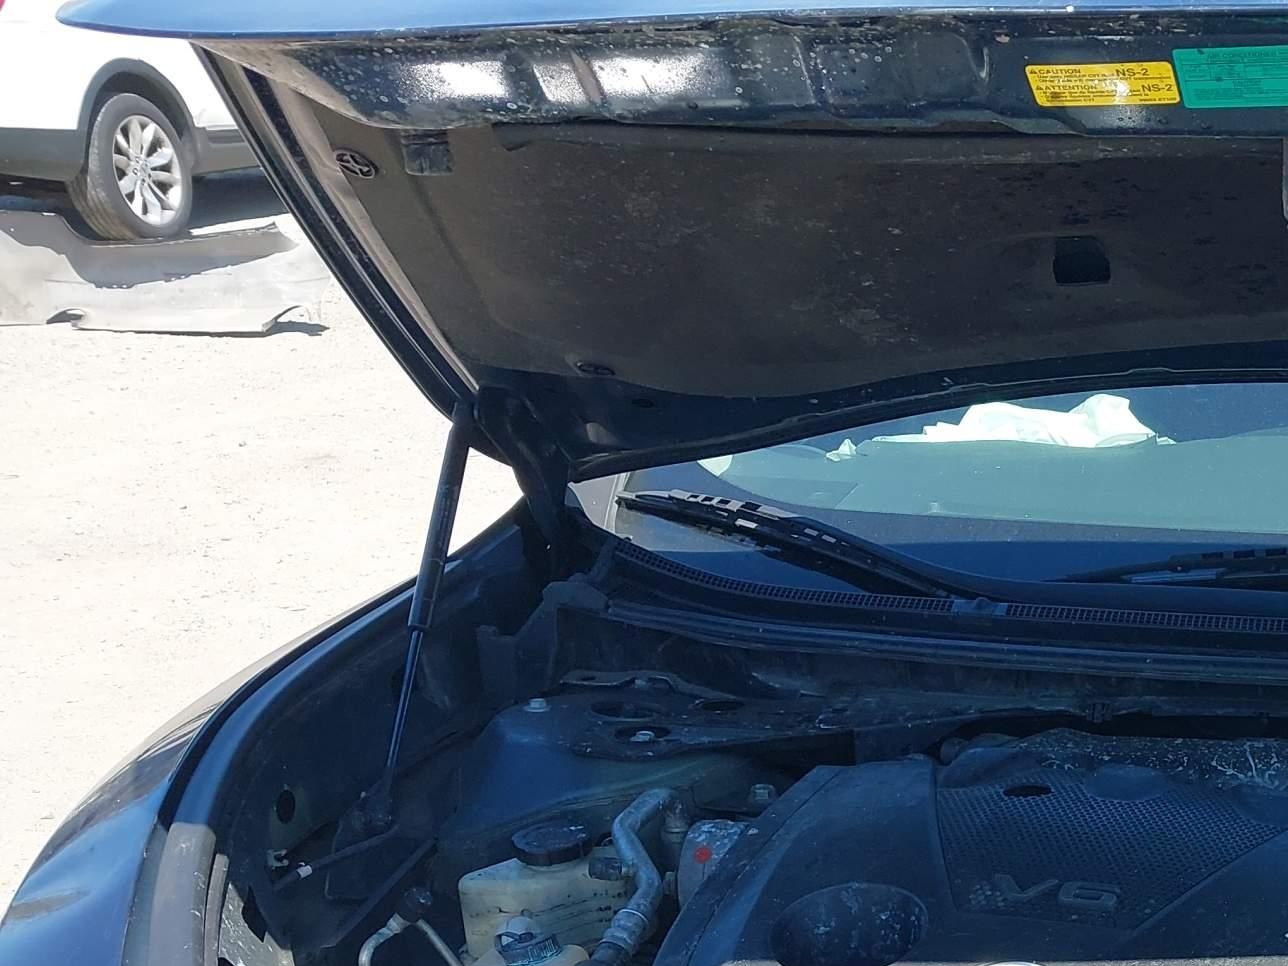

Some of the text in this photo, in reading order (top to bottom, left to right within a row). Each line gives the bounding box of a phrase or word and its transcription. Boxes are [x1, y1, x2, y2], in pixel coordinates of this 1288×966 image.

[1115, 67, 1149, 77] NS-2
[1141, 83, 1173, 93] NS-2
[994, 873, 1122, 911] V6
